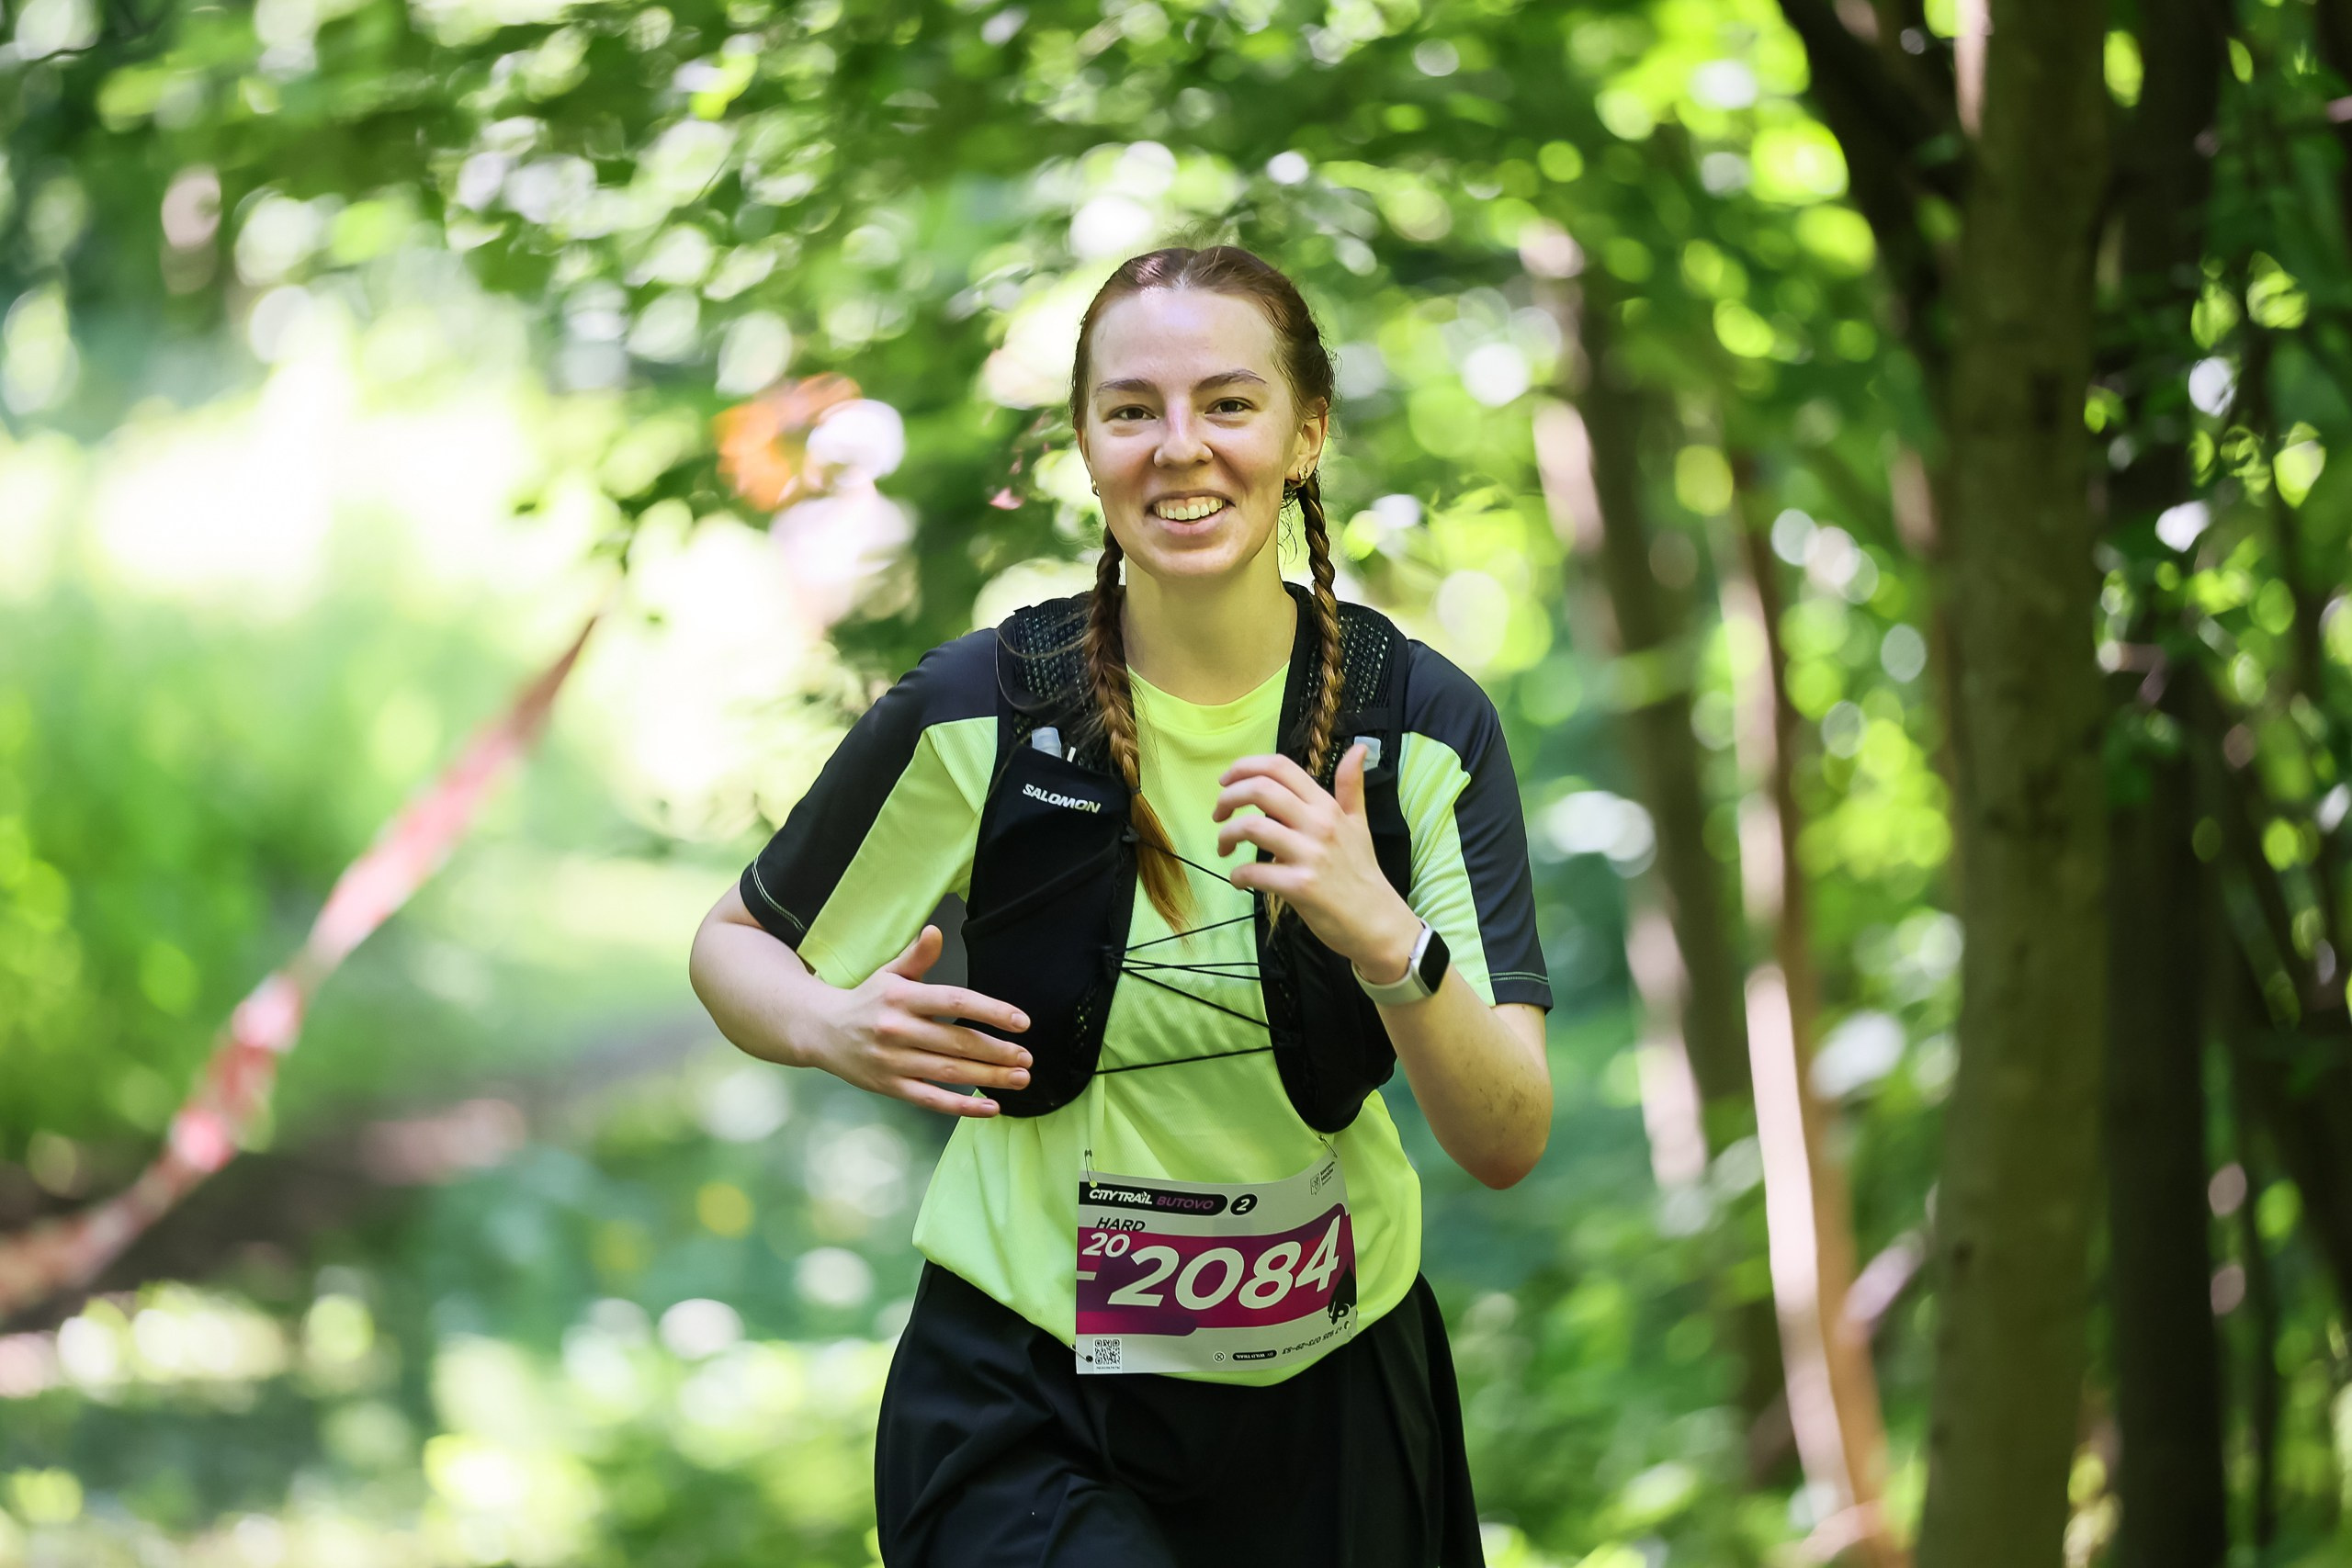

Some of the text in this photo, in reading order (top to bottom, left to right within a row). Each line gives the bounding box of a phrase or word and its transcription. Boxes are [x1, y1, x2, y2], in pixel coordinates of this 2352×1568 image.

[1022, 783, 1102, 814] SALOMON
[1156, 1195, 1215, 1210] BUTOVO
[1236, 1198, 1250, 1212] 2
[1096, 1216, 1147, 1232] HARD
[1081, 1232, 1131, 1258] 20
[1106, 1214, 1341, 1311] 2084
